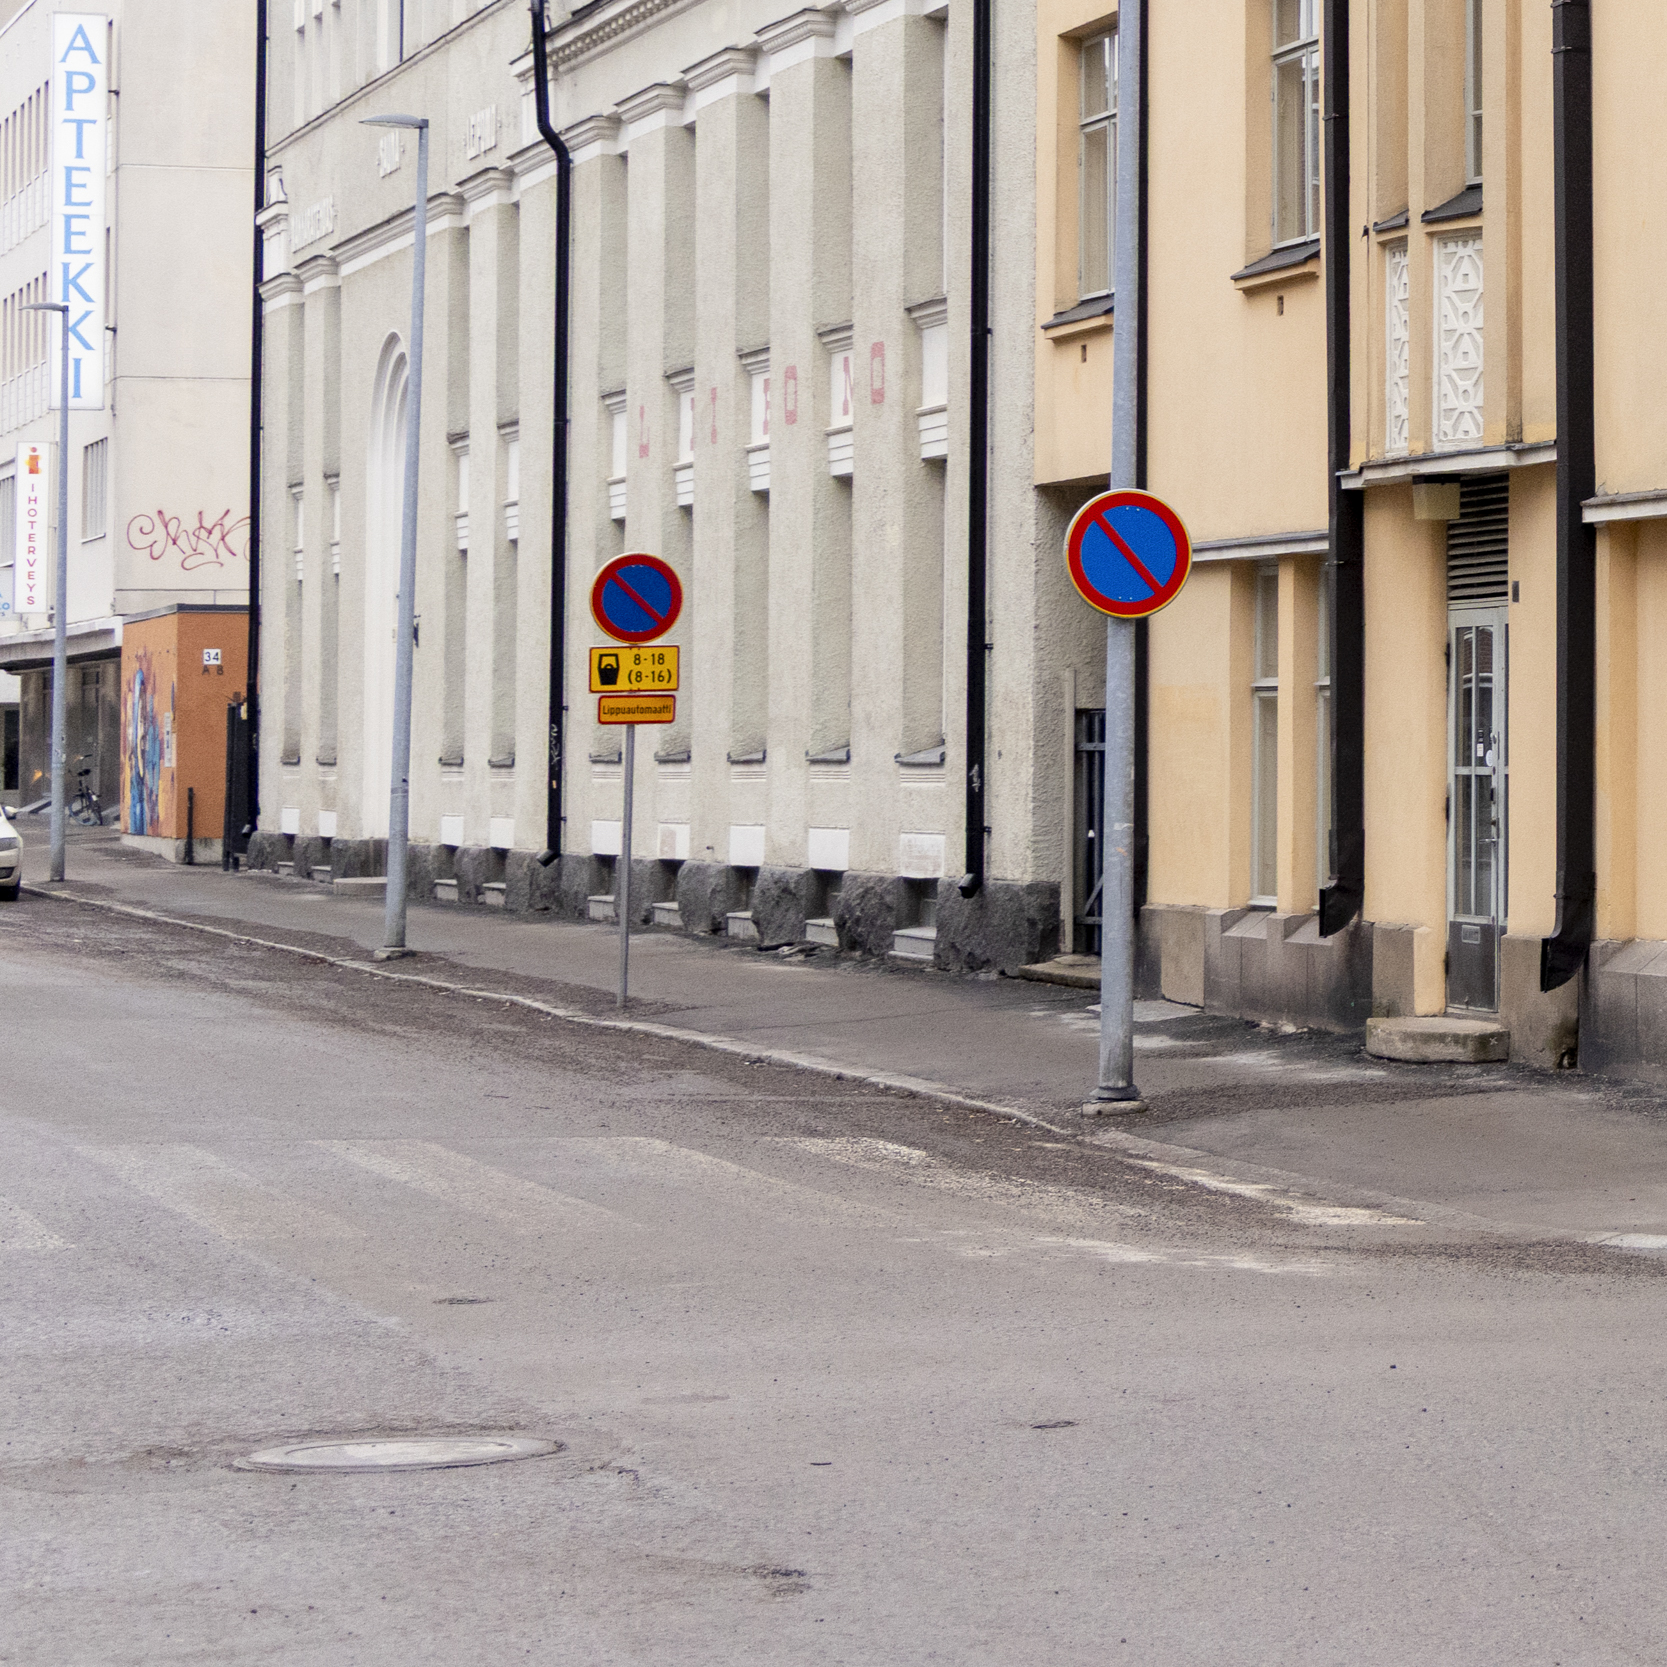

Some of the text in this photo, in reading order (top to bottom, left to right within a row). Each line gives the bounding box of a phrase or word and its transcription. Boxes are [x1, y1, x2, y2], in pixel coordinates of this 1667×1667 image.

[58, 23, 103, 399] APTEEKKI
[26, 483, 38, 606] IHOTERVEYS
[204, 651, 220, 663] 34
[633, 653, 666, 666] 8-18
[627, 668, 673, 685] (8-16)
[602, 704, 672, 717] Lippuautomaatti
